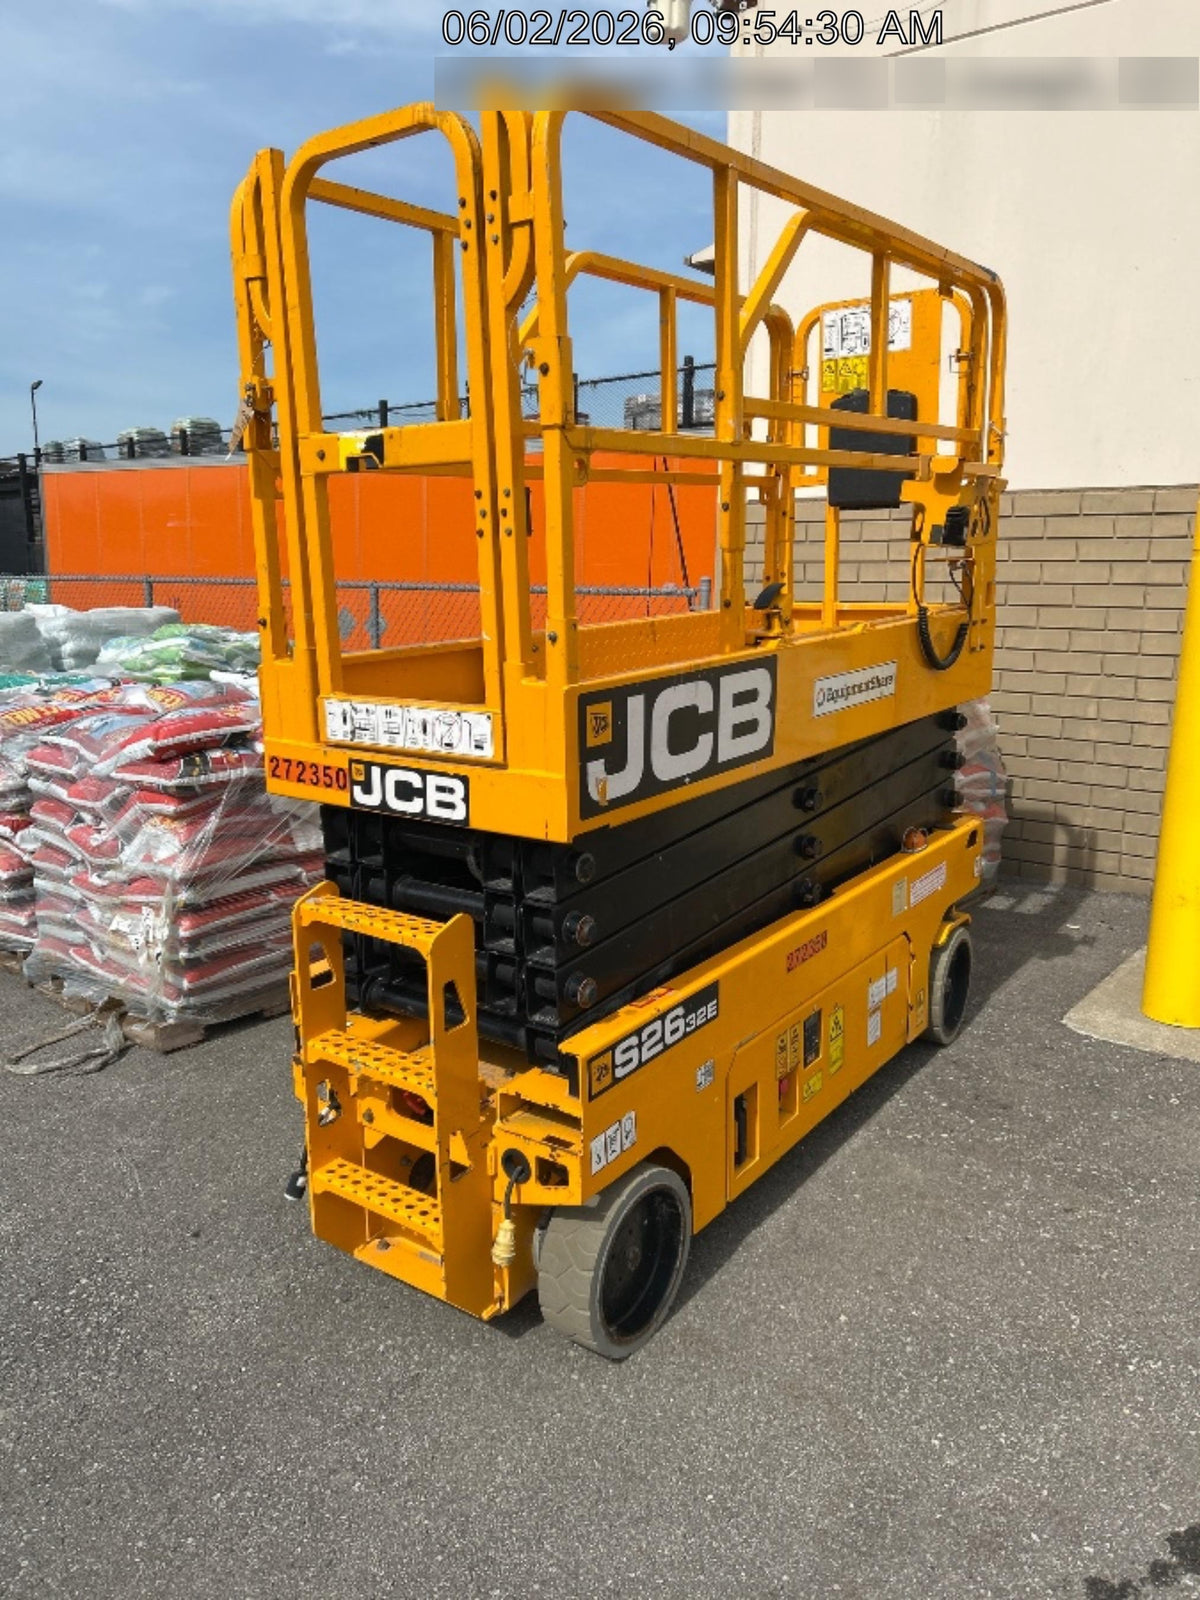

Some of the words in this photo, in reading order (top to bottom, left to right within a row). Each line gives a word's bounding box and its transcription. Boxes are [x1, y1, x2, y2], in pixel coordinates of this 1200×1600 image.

[586, 667, 772, 802] JCB
[269, 756, 348, 791] 272350
[352, 765, 467, 821] JCB
